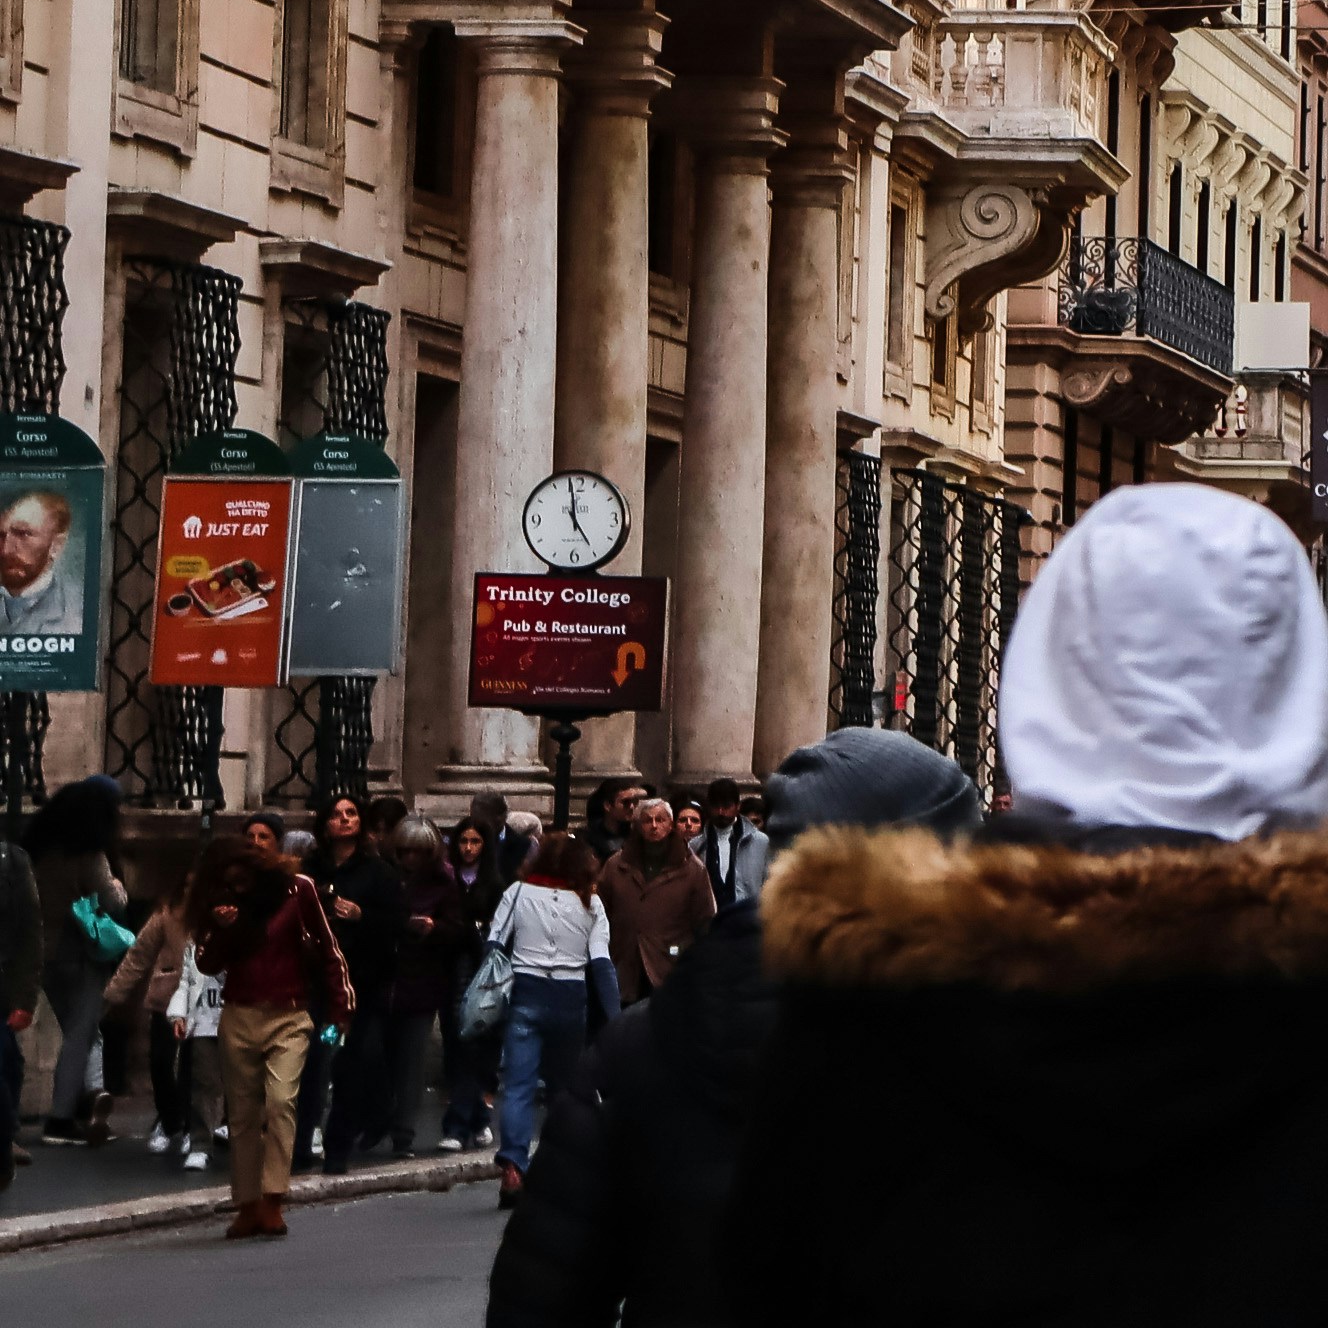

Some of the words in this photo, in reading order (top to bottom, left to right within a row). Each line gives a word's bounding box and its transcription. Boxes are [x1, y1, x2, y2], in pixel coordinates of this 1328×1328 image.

[16, 431, 47, 442] Corso
[221, 448, 248, 459] Corso
[323, 448, 349, 459] Corso
[206, 523, 240, 537] JUST
[242, 523, 270, 537] EAT
[486, 585, 555, 605] Trinity
[560, 588, 631, 608] College
[503, 619, 531, 633] Pub
[534, 621, 547, 633] &
[551, 621, 627, 635] Restaurant
[11, 637, 75, 653] GOGH
[480, 679, 528, 690] GUINNESS
